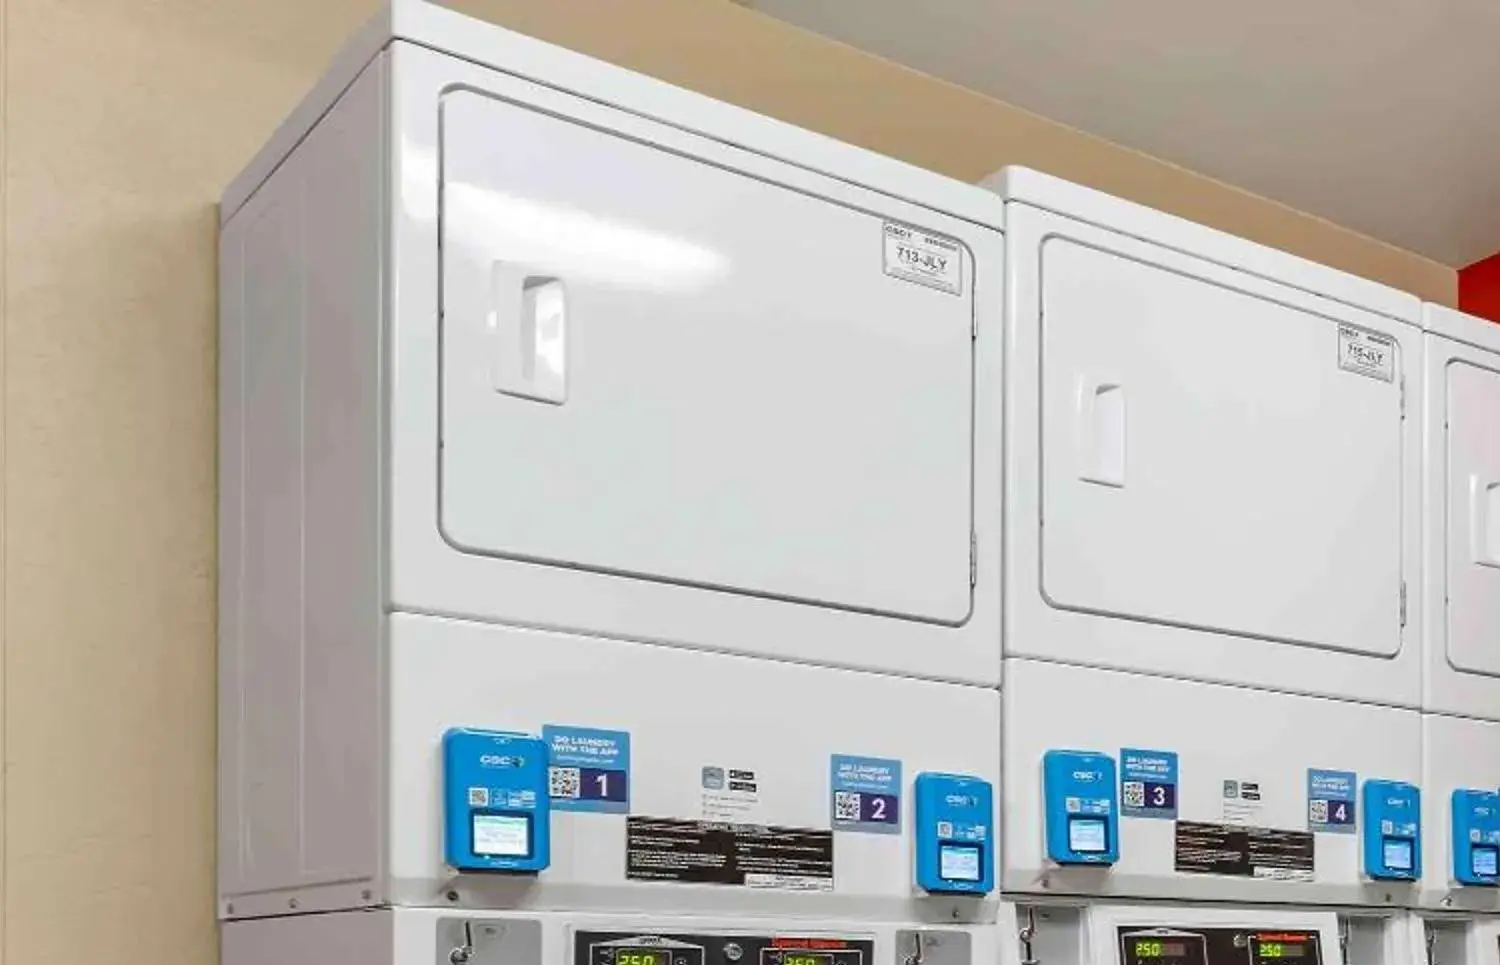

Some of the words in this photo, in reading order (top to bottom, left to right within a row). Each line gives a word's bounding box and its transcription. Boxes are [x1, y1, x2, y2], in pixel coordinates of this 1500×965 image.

[597, 773, 609, 797] 1
[1153, 786, 1166, 806] 3
[871, 797, 886, 819] 2
[1335, 803, 1347, 821] 4
